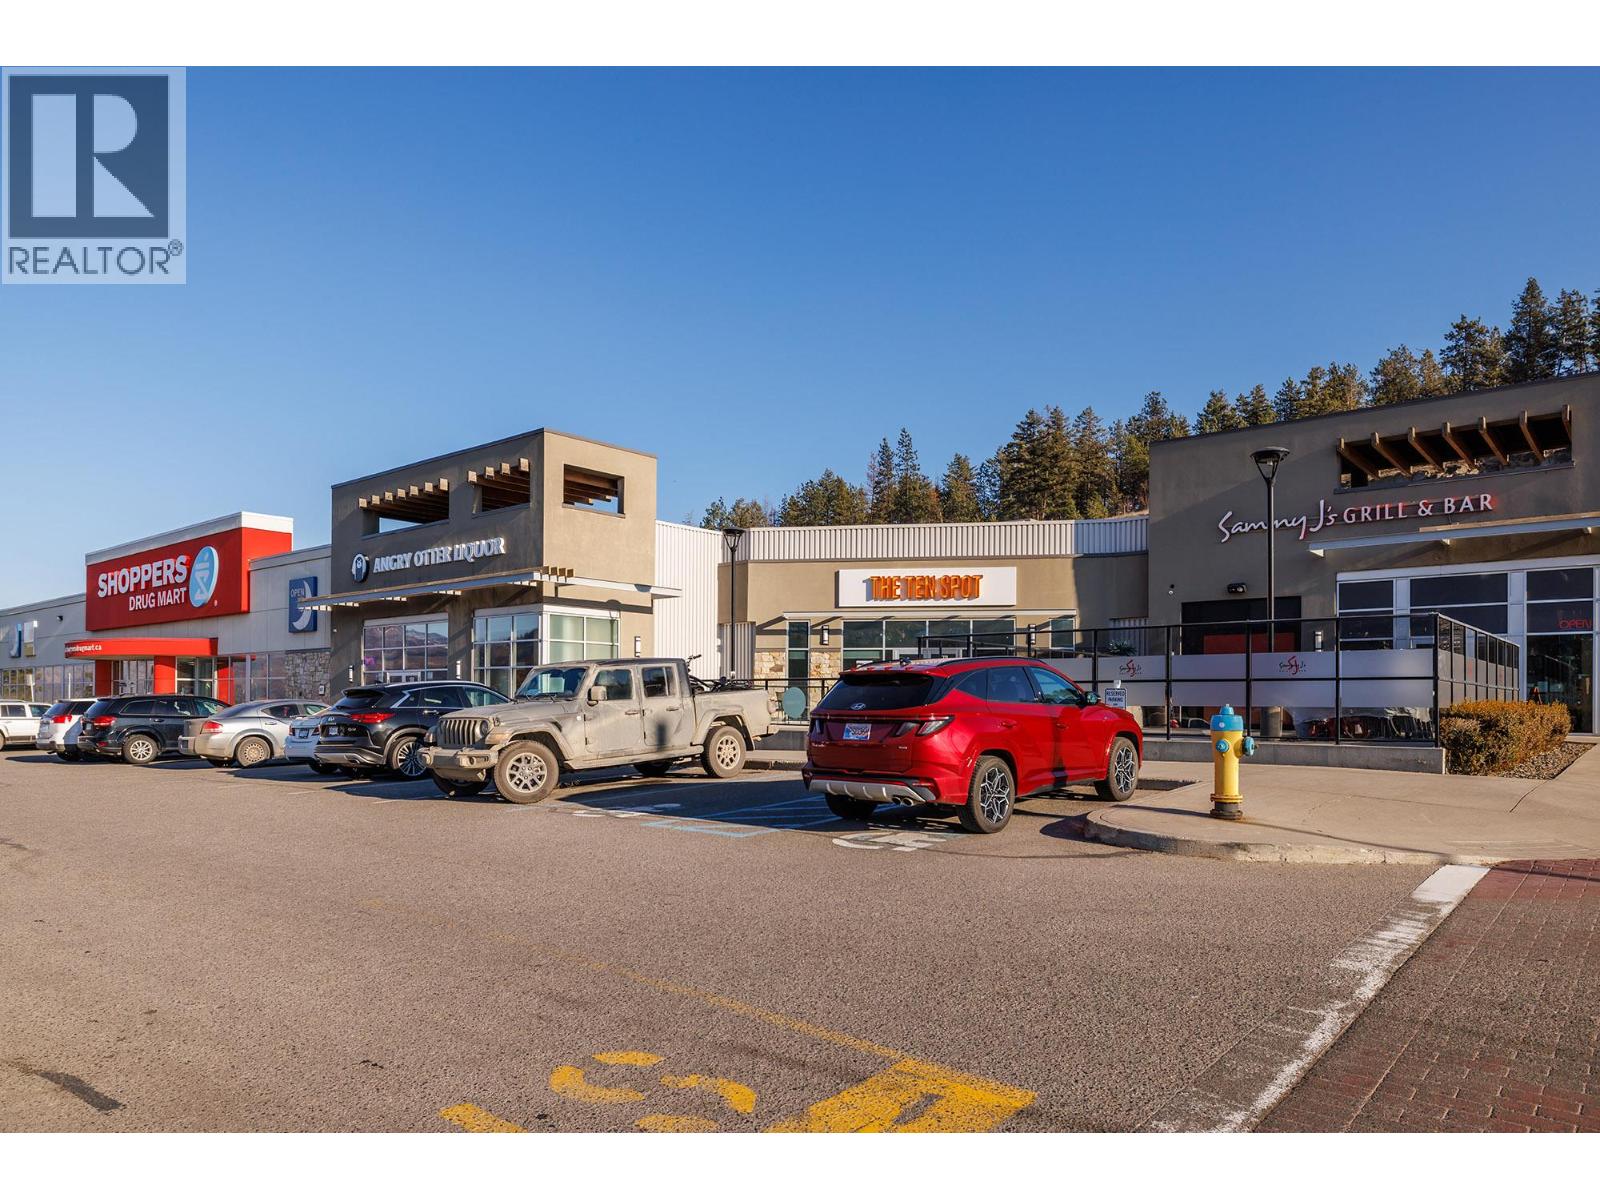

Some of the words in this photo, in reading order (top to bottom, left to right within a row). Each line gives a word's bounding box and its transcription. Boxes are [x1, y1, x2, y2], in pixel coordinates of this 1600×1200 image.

[1309, 500, 1338, 532] J's
[1343, 502, 1408, 524] GRILL
[1417, 499, 1433, 517] &
[1444, 493, 1494, 514] BAR
[373, 552, 413, 574] ANGRY
[413, 545, 452, 567] OTTER
[453, 537, 506, 563] LIQUOR
[97, 555, 189, 598] SHOPPERS
[870, 575, 901, 600] THE
[904, 575, 936, 600] TEN
[939, 574, 984, 600] SPOT
[128, 592, 156, 611] DRUG
[157, 587, 188, 607] MART
